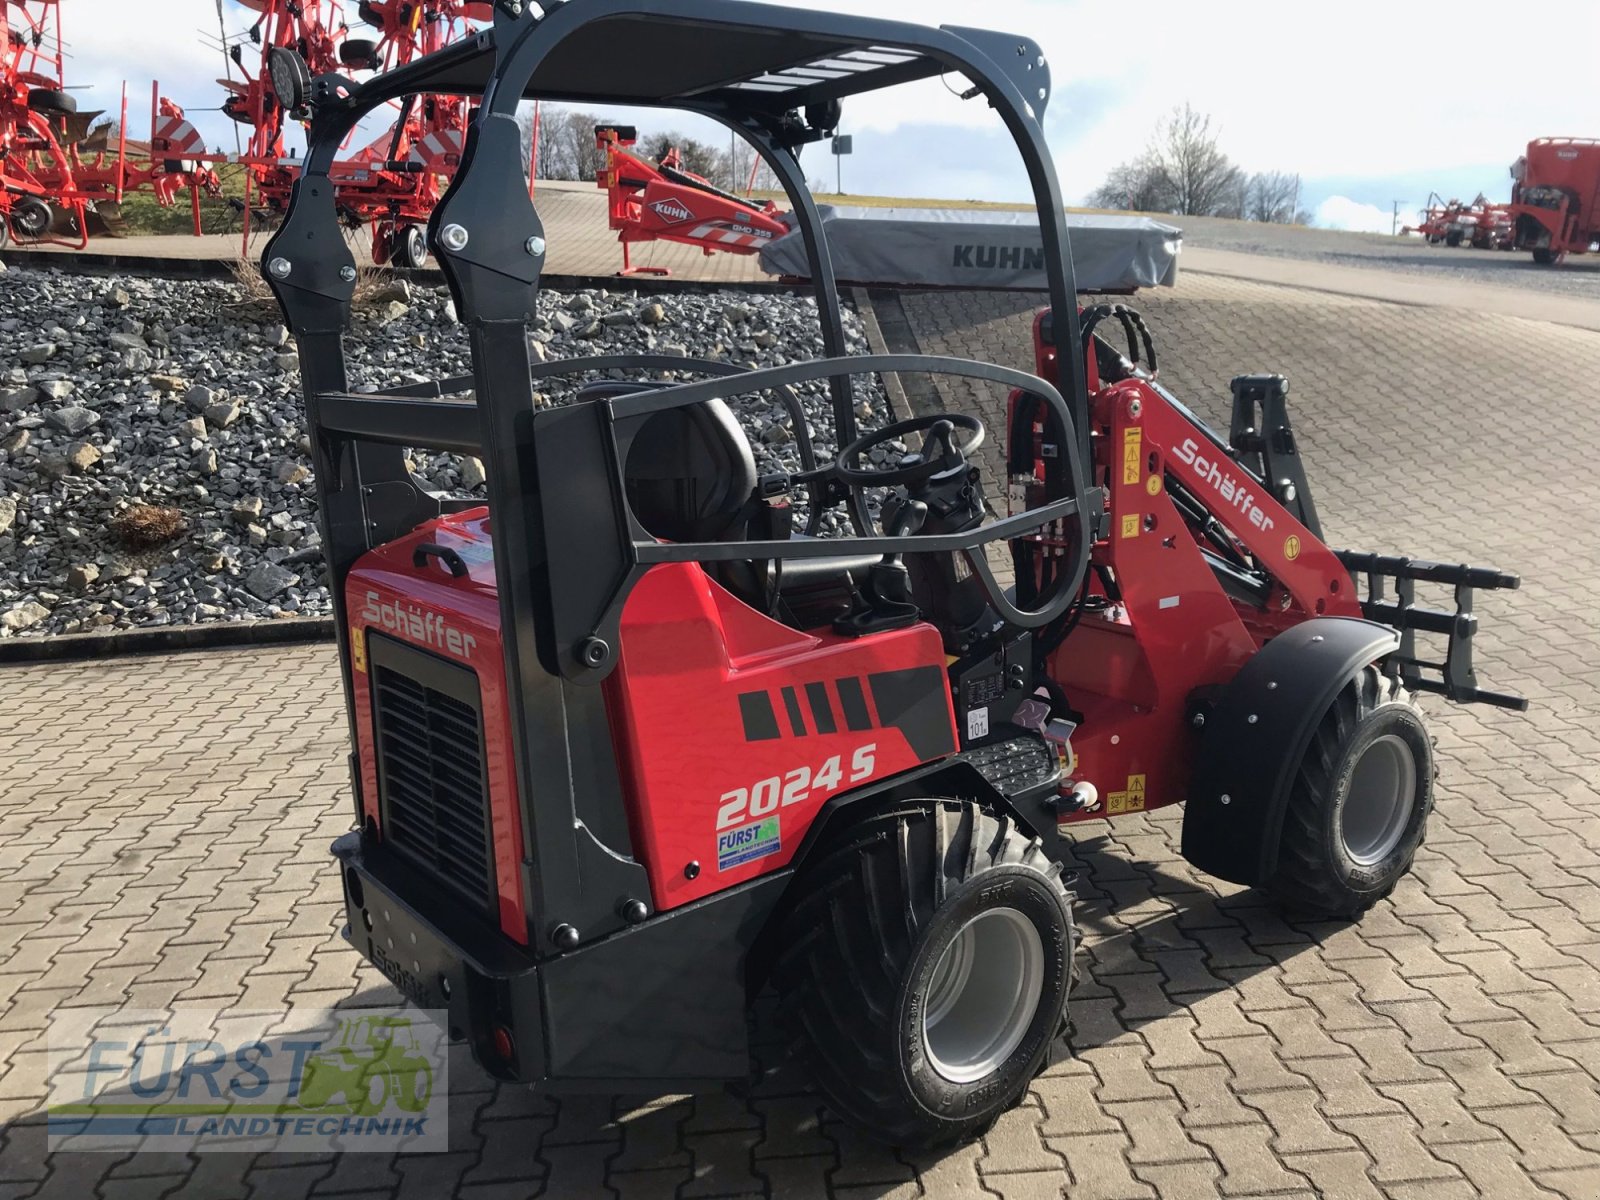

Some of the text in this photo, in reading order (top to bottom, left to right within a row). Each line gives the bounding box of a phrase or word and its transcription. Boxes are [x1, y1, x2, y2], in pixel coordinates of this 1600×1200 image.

[655, 203, 689, 220] KUHN
[732, 224, 772, 239] GMD 355
[952, 244, 1045, 270] KUHN
[1172, 438, 1275, 532] Schäffer
[362, 591, 477, 659] Schäffer
[716, 743, 877, 830] 2024 S
[719, 824, 761, 852] FÜRST
